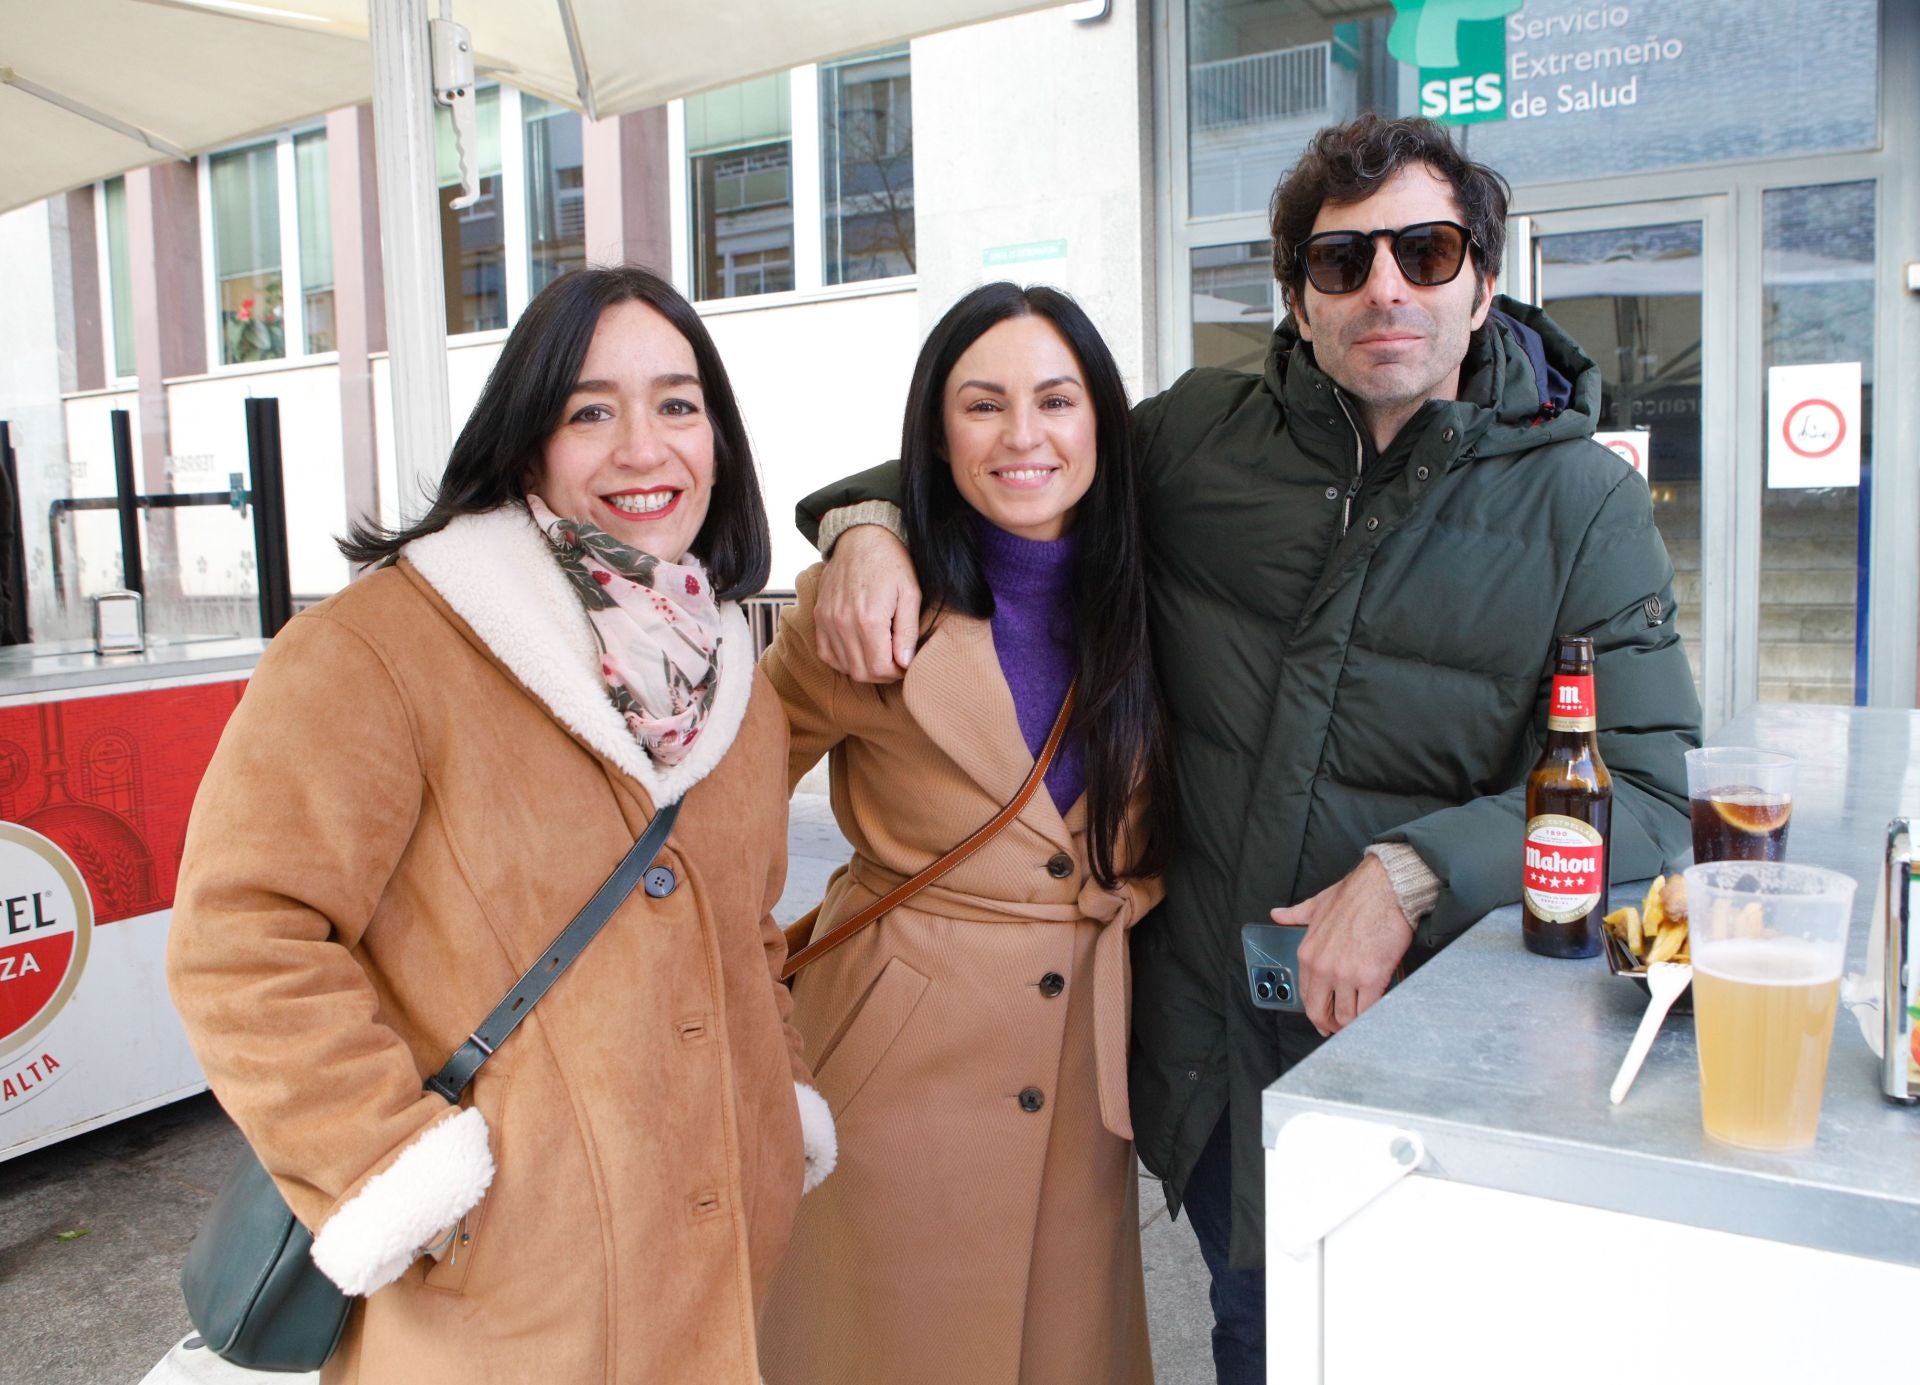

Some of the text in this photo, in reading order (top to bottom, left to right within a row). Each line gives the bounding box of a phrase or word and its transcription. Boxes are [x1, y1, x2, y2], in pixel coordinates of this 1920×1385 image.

[1508, 6, 1629, 42] Servicio
[1511, 36, 1683, 80] Extremeño
[1421, 73, 1502, 118] SES
[1510, 75, 1638, 119] de Salud
[1525, 846, 1597, 873] Mahou
[0, 892, 56, 934] EL
